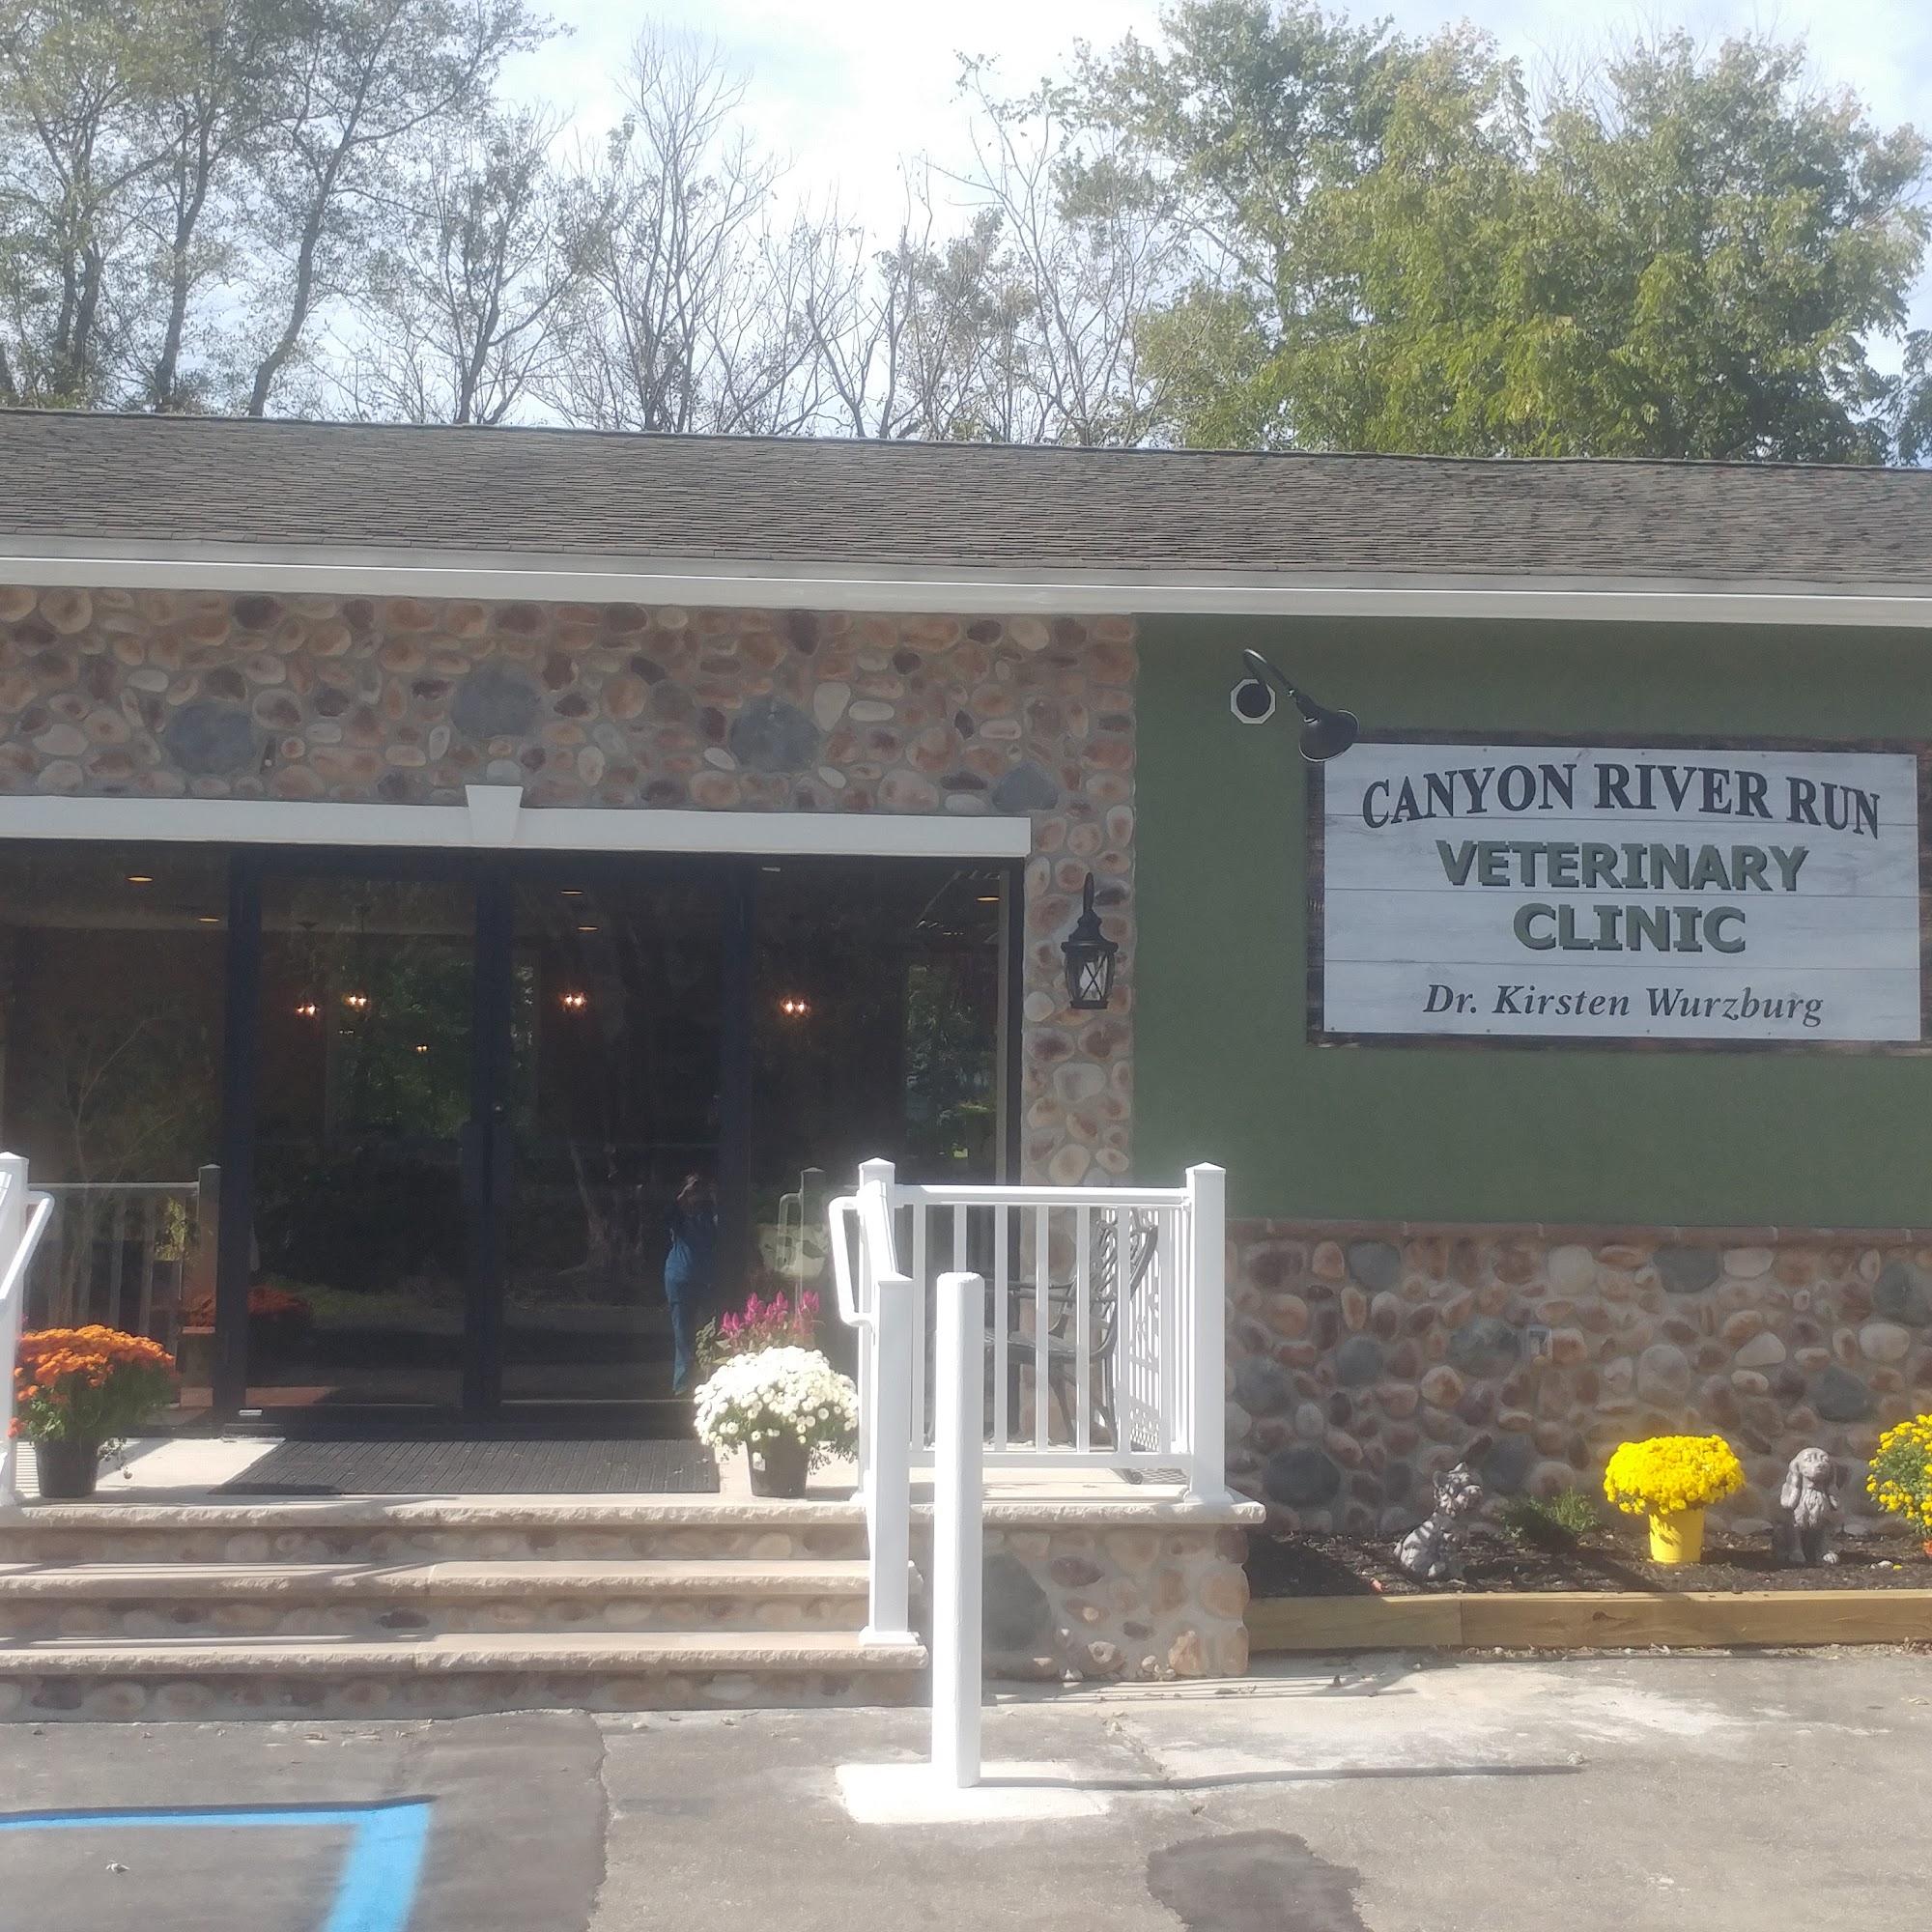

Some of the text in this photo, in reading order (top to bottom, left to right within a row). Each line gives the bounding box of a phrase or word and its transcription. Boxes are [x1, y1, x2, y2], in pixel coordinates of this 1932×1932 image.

[1362, 763, 1880, 839] CANYON RIVER RUN
[1435, 839, 1809, 892] VETERINARY
[1513, 902, 1747, 953] CLINIC
[1423, 983, 1824, 1028] Dr. Kirsten Wurzburg
